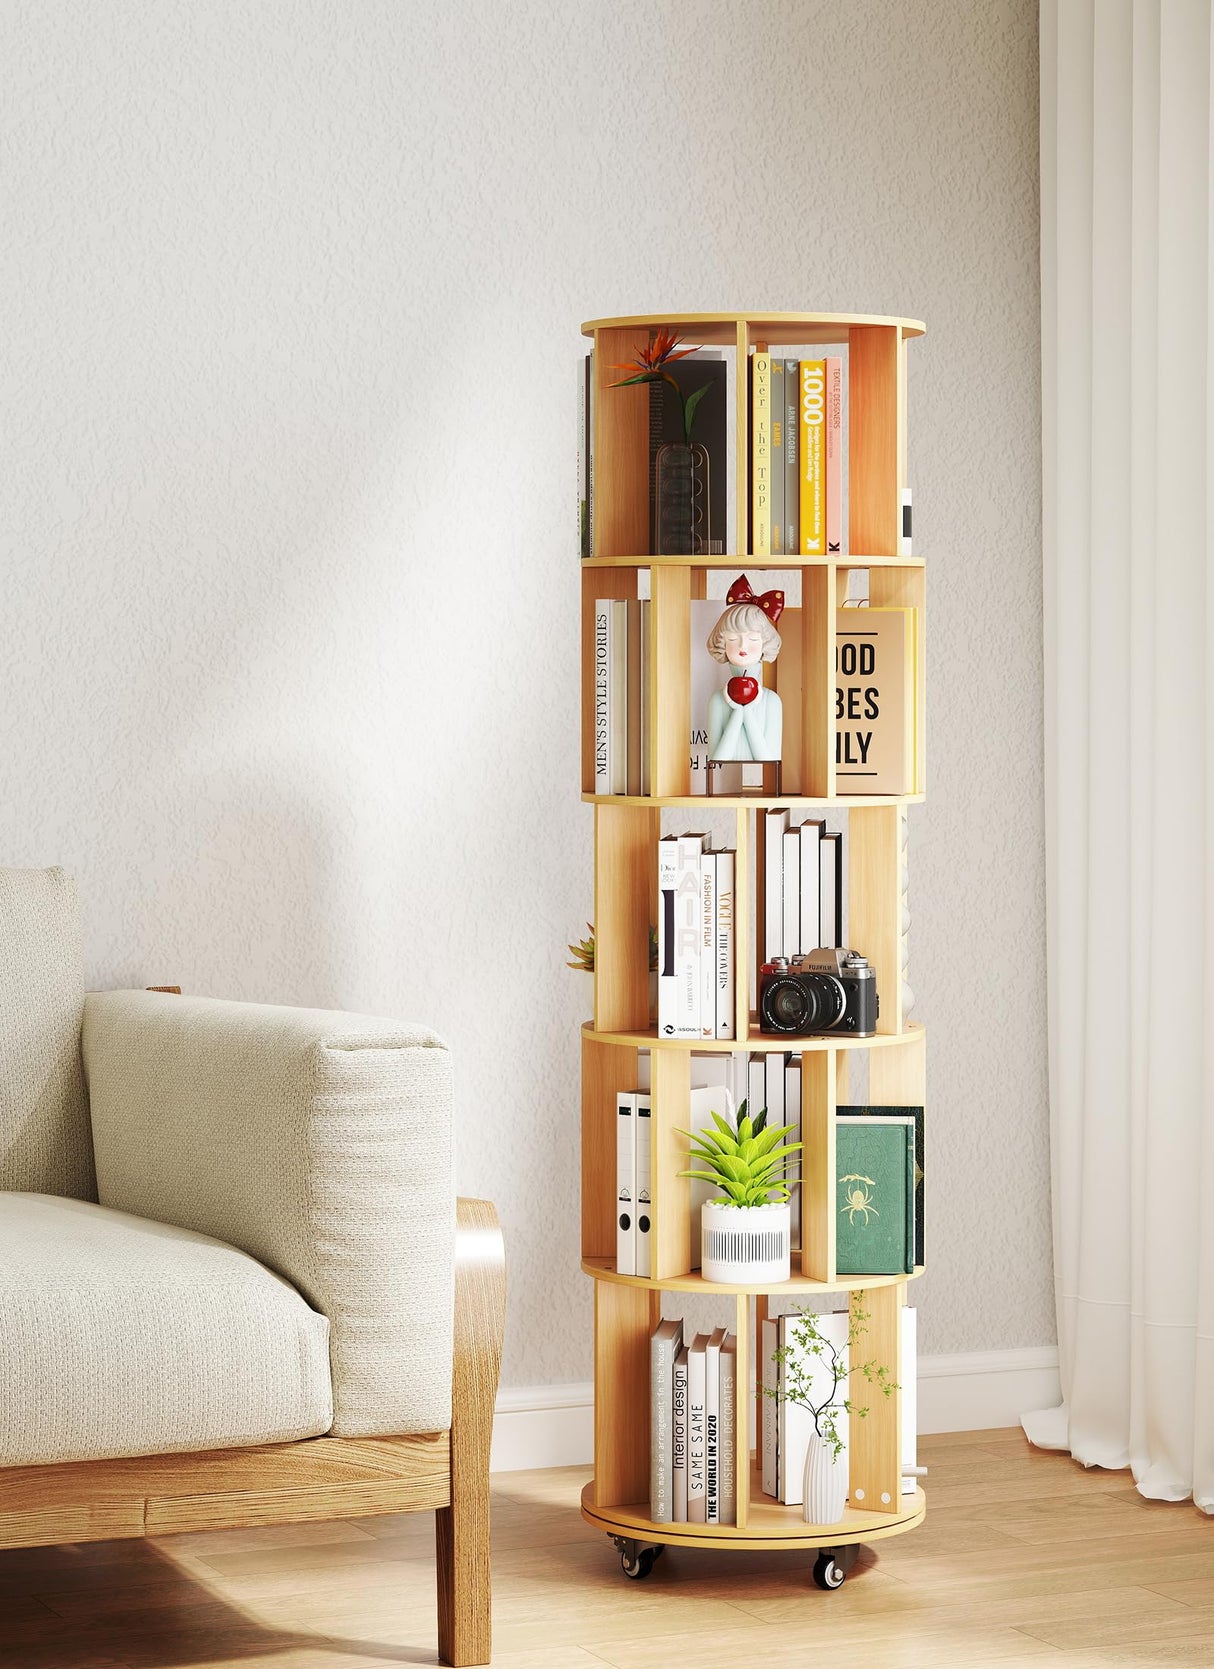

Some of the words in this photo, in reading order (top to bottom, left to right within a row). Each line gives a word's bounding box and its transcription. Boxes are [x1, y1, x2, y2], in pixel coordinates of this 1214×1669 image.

[757, 359, 767, 406] Over
[803, 367, 824, 425] 1000
[833, 368, 841, 392] TEXTILE
[788, 405, 796, 425] ARNE
[833, 393, 841, 430] DESIGNERS
[758, 422, 766, 455] the
[788, 426, 796, 464] JACOBSEN
[757, 467, 767, 507] Top
[596, 614, 607, 677] STORIES
[836, 643, 875, 676] OD
[596, 681, 607, 727] STYLE
[596, 730, 607, 776] MEN'S
[703, 874, 712, 914] FASHION
[719, 891, 732, 931] VOGUE
[703, 915, 712, 925] IN
[703, 926, 712, 947] FILM
[656, 1343, 665, 1366] house
[656, 1370, 665, 1384] the
[656, 1387, 665, 1397] in
[673, 1370, 687, 1417] design
[691, 1404, 703, 1443] SAME
[723, 1376, 733, 1434] DECORATES
[657, 1400, 669, 1449] arrangement
[707, 1414, 717, 1443] 2020
[658, 1453, 665, 1463] an
[673, 1420, 685, 1470] Interior
[707, 1445, 717, 1457] IN
[656, 1466, 665, 1486] make
[691, 1451, 703, 1490] SAME
[707, 1459, 717, 1498] WORLD
[723, 1439, 733, 1498] HOUSEHOLD
[656, 1502, 665, 1517] How
[657, 1488, 665, 1499] to
[707, 1499, 717, 1519] THE
